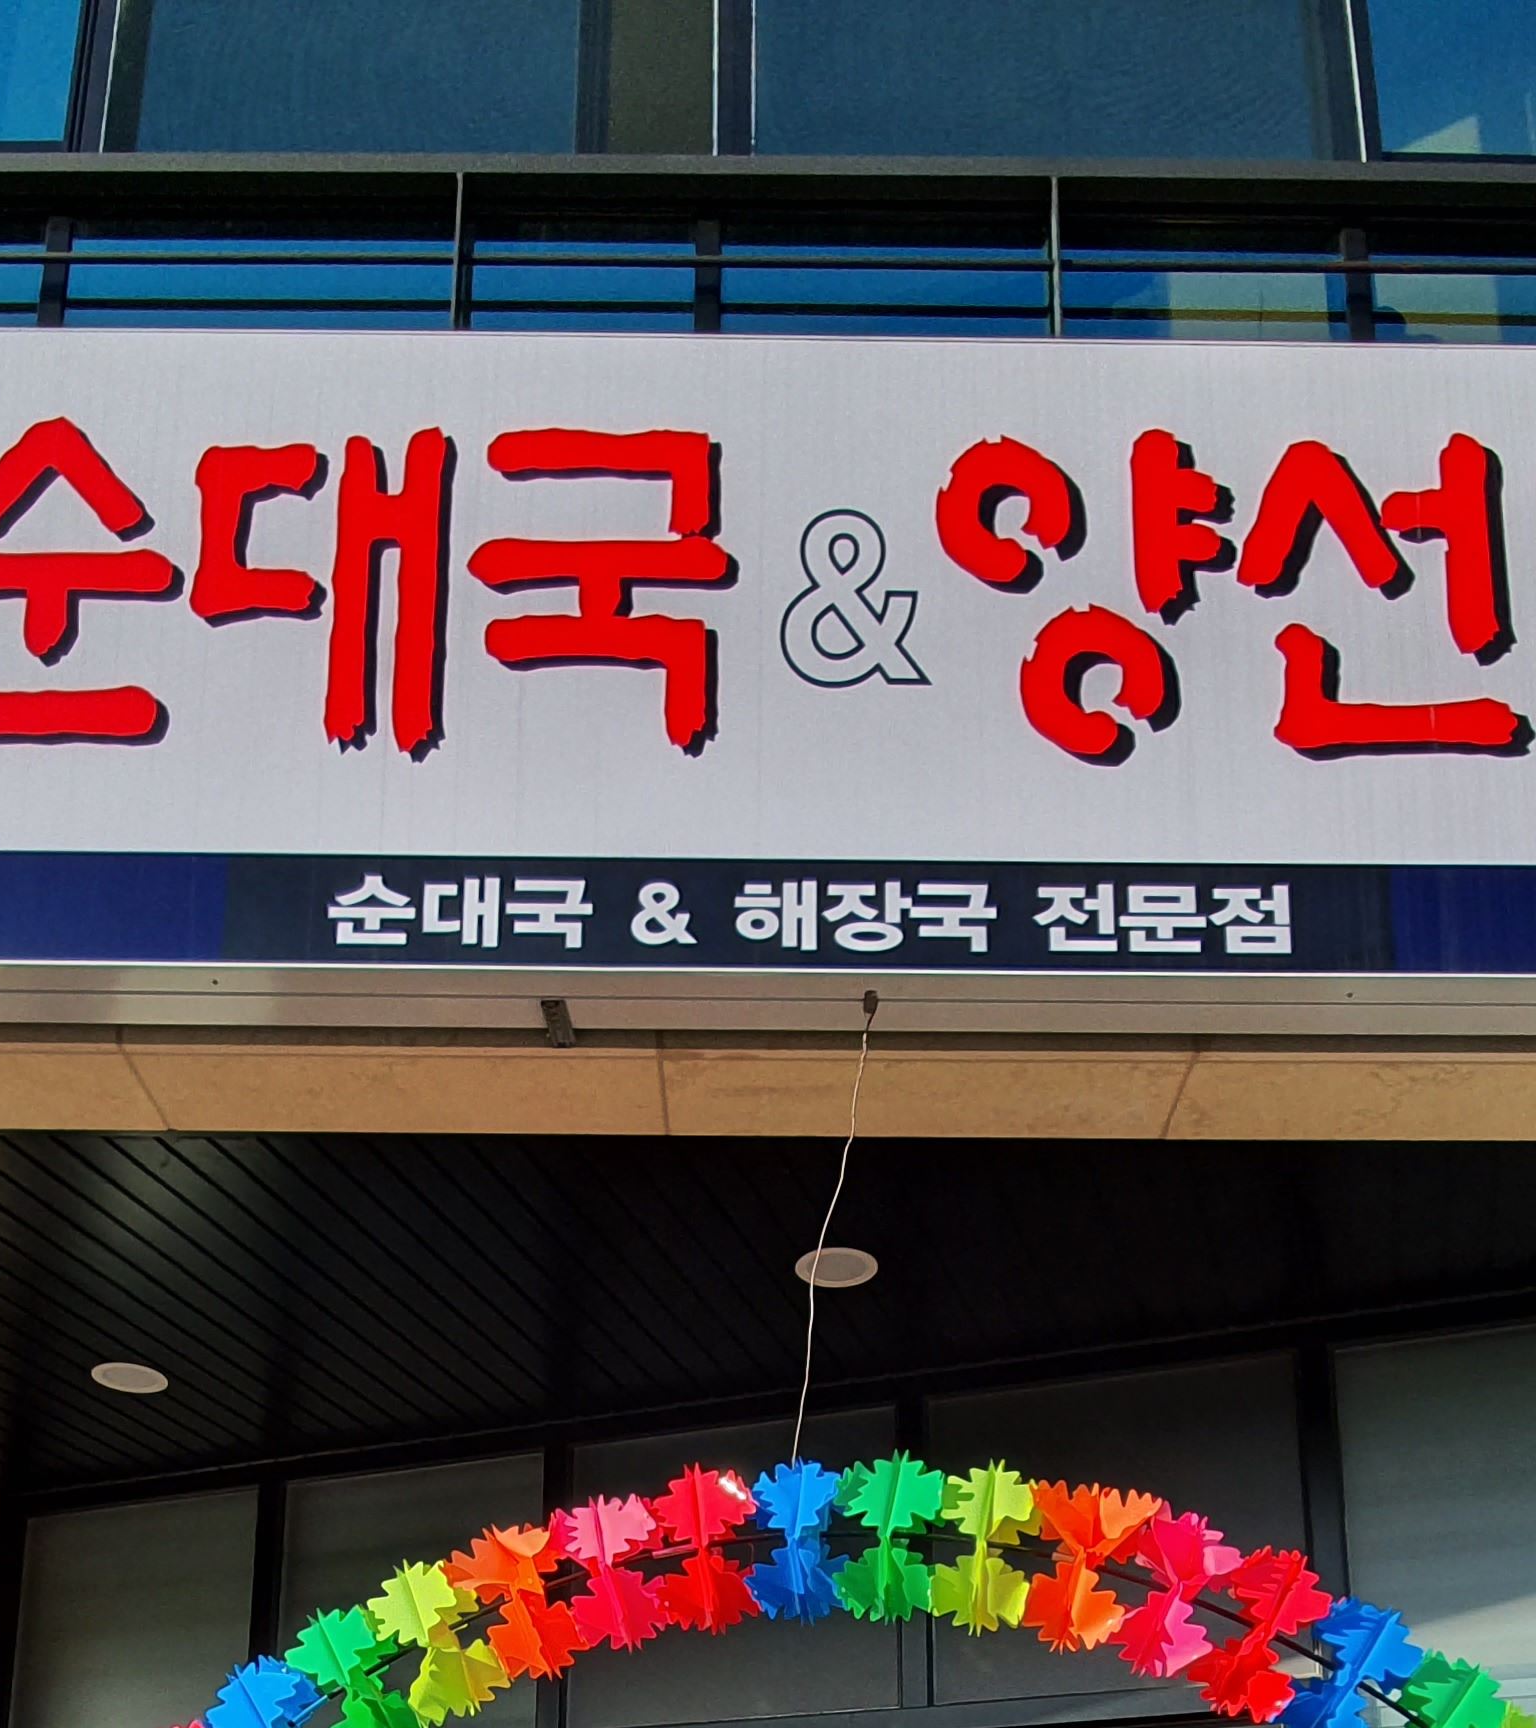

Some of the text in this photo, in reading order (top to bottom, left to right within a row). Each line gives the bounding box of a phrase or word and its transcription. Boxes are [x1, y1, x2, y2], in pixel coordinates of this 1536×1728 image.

[326, 872, 1293, 955] 순대국 & 해장국 전문점
